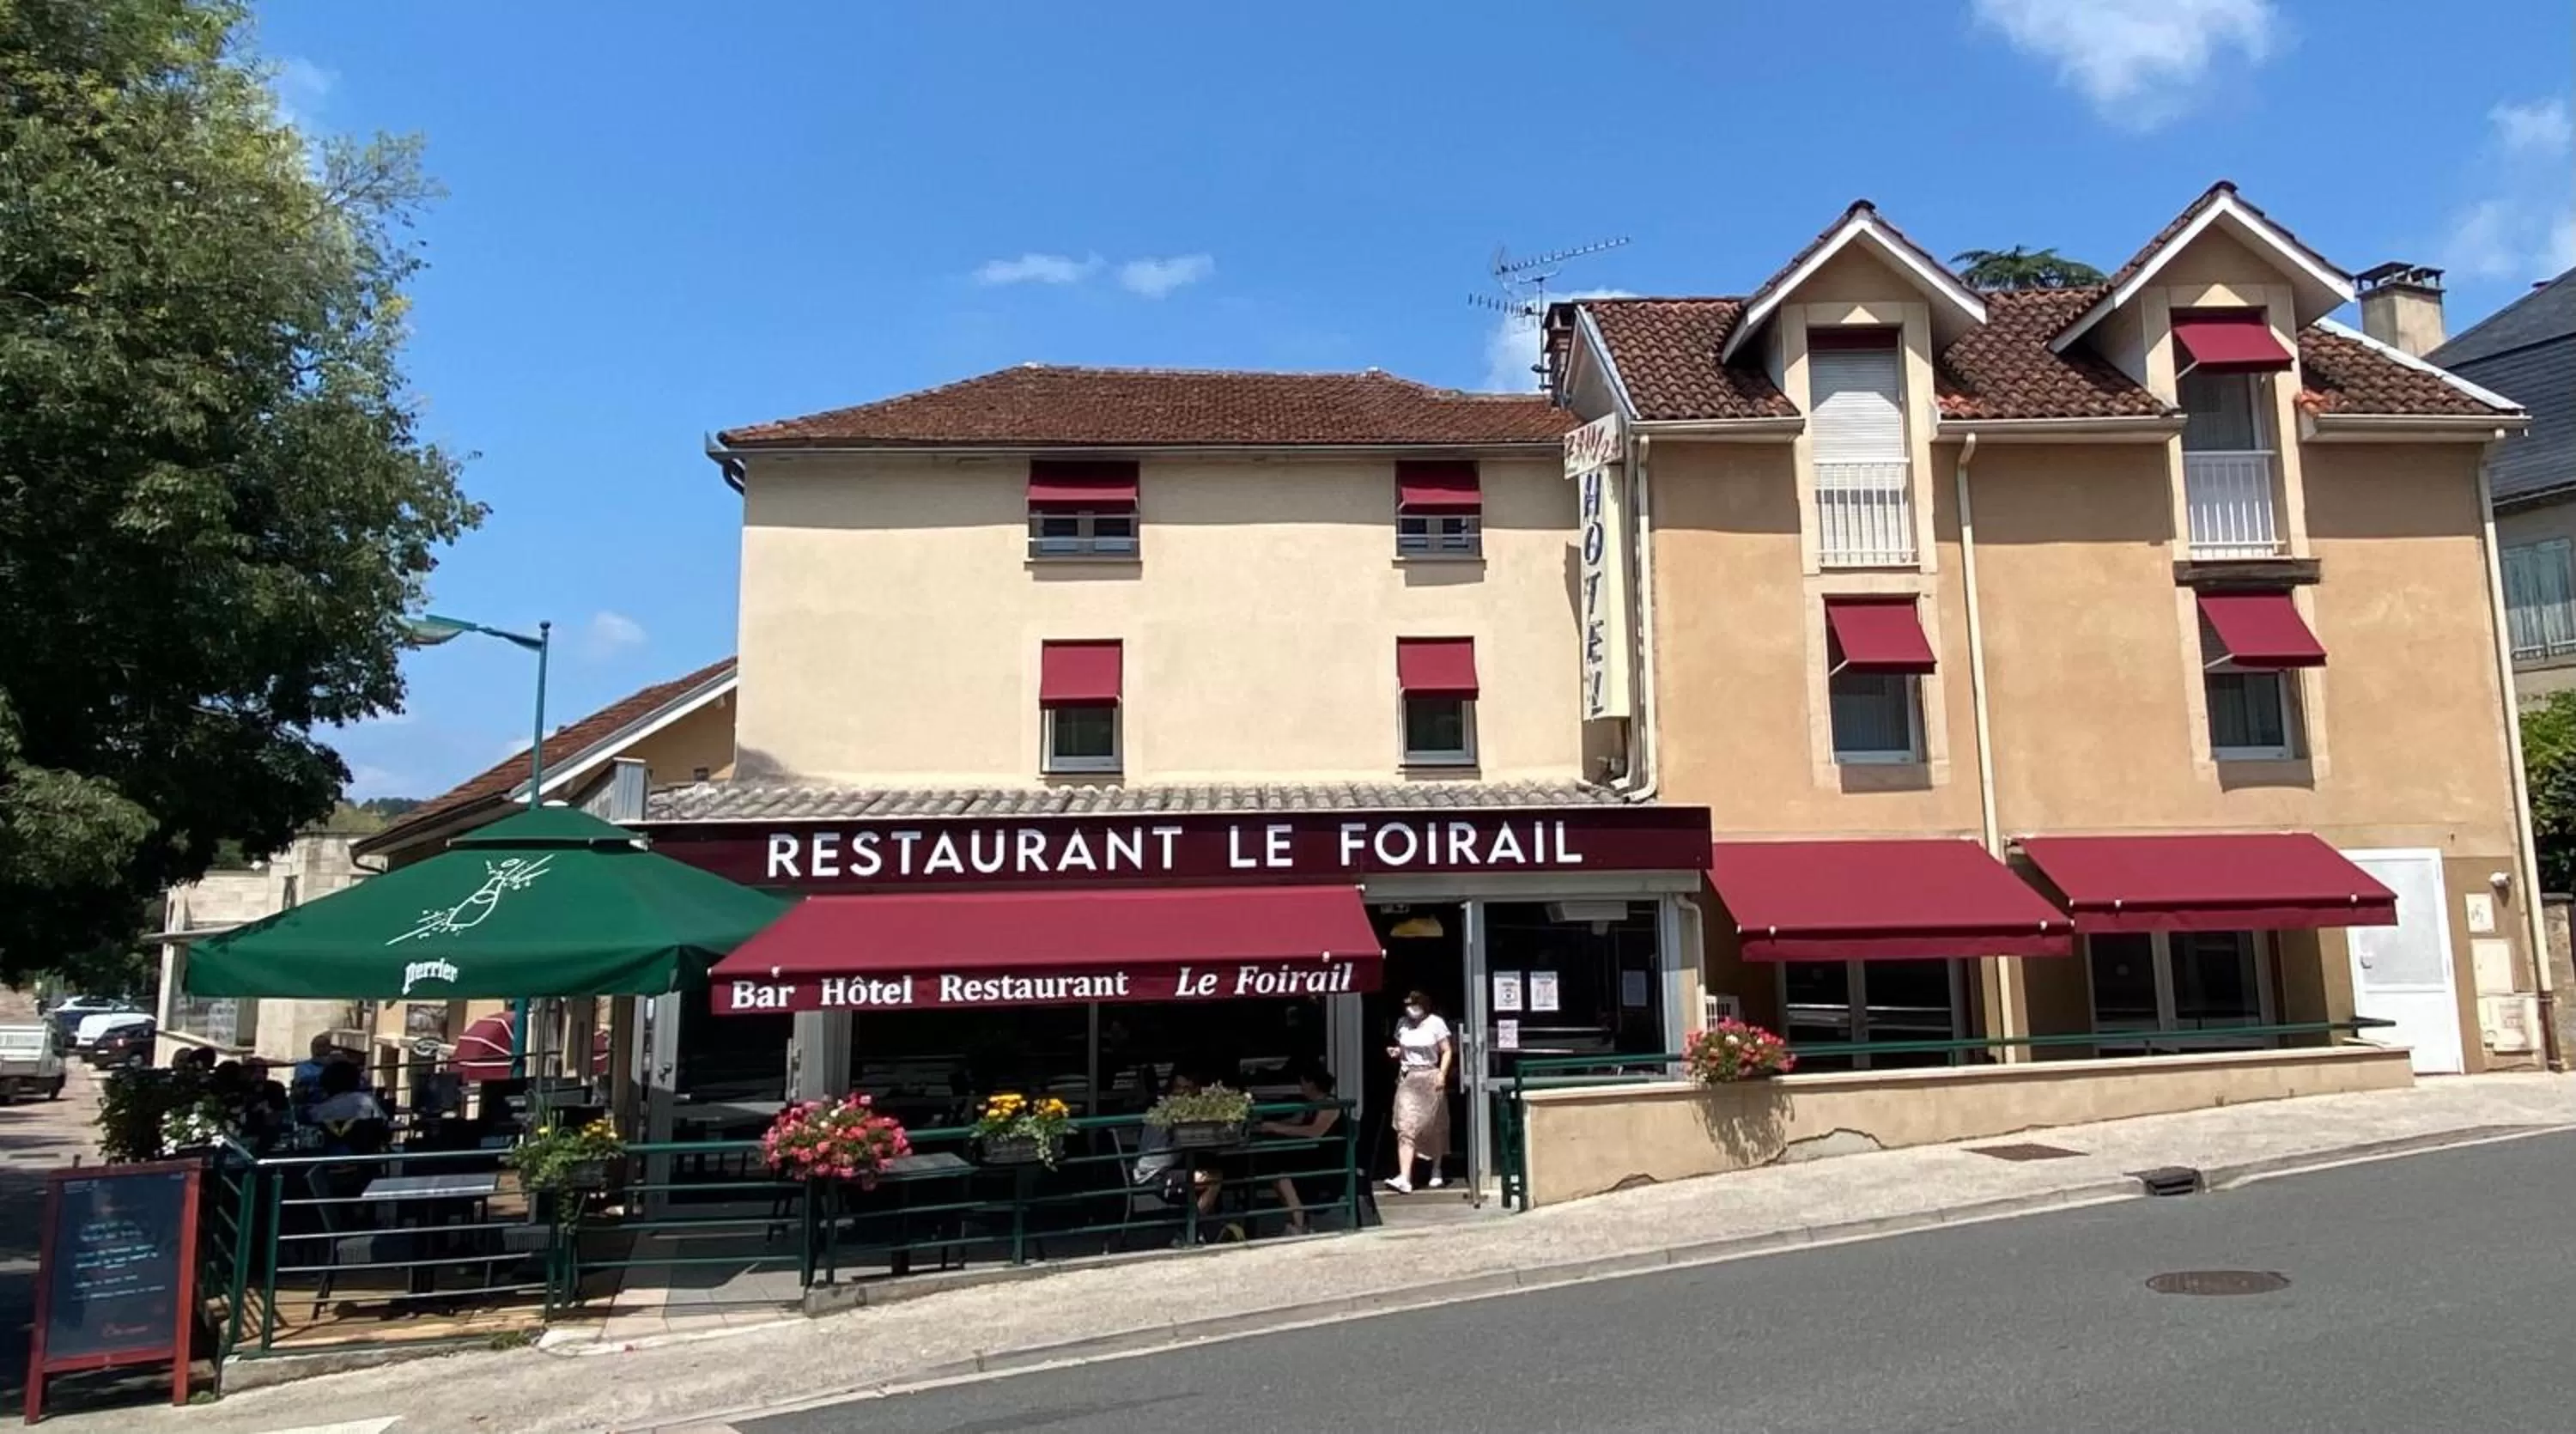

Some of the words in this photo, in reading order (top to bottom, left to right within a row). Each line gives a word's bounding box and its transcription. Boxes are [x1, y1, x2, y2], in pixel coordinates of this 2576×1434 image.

[1583, 471, 1604, 718] HOTEL
[768, 826, 1182, 878] RESTAURANT
[1229, 824, 1292, 868] LE
[1340, 821, 1583, 866] FOIRAIL
[731, 980, 796, 1009] Bar
[821, 975, 913, 1006] Hôtel
[939, 971, 1129, 1002] Restaurant
[1175, 967, 1218, 997] Le
[1234, 962, 1354, 995] Foirail
